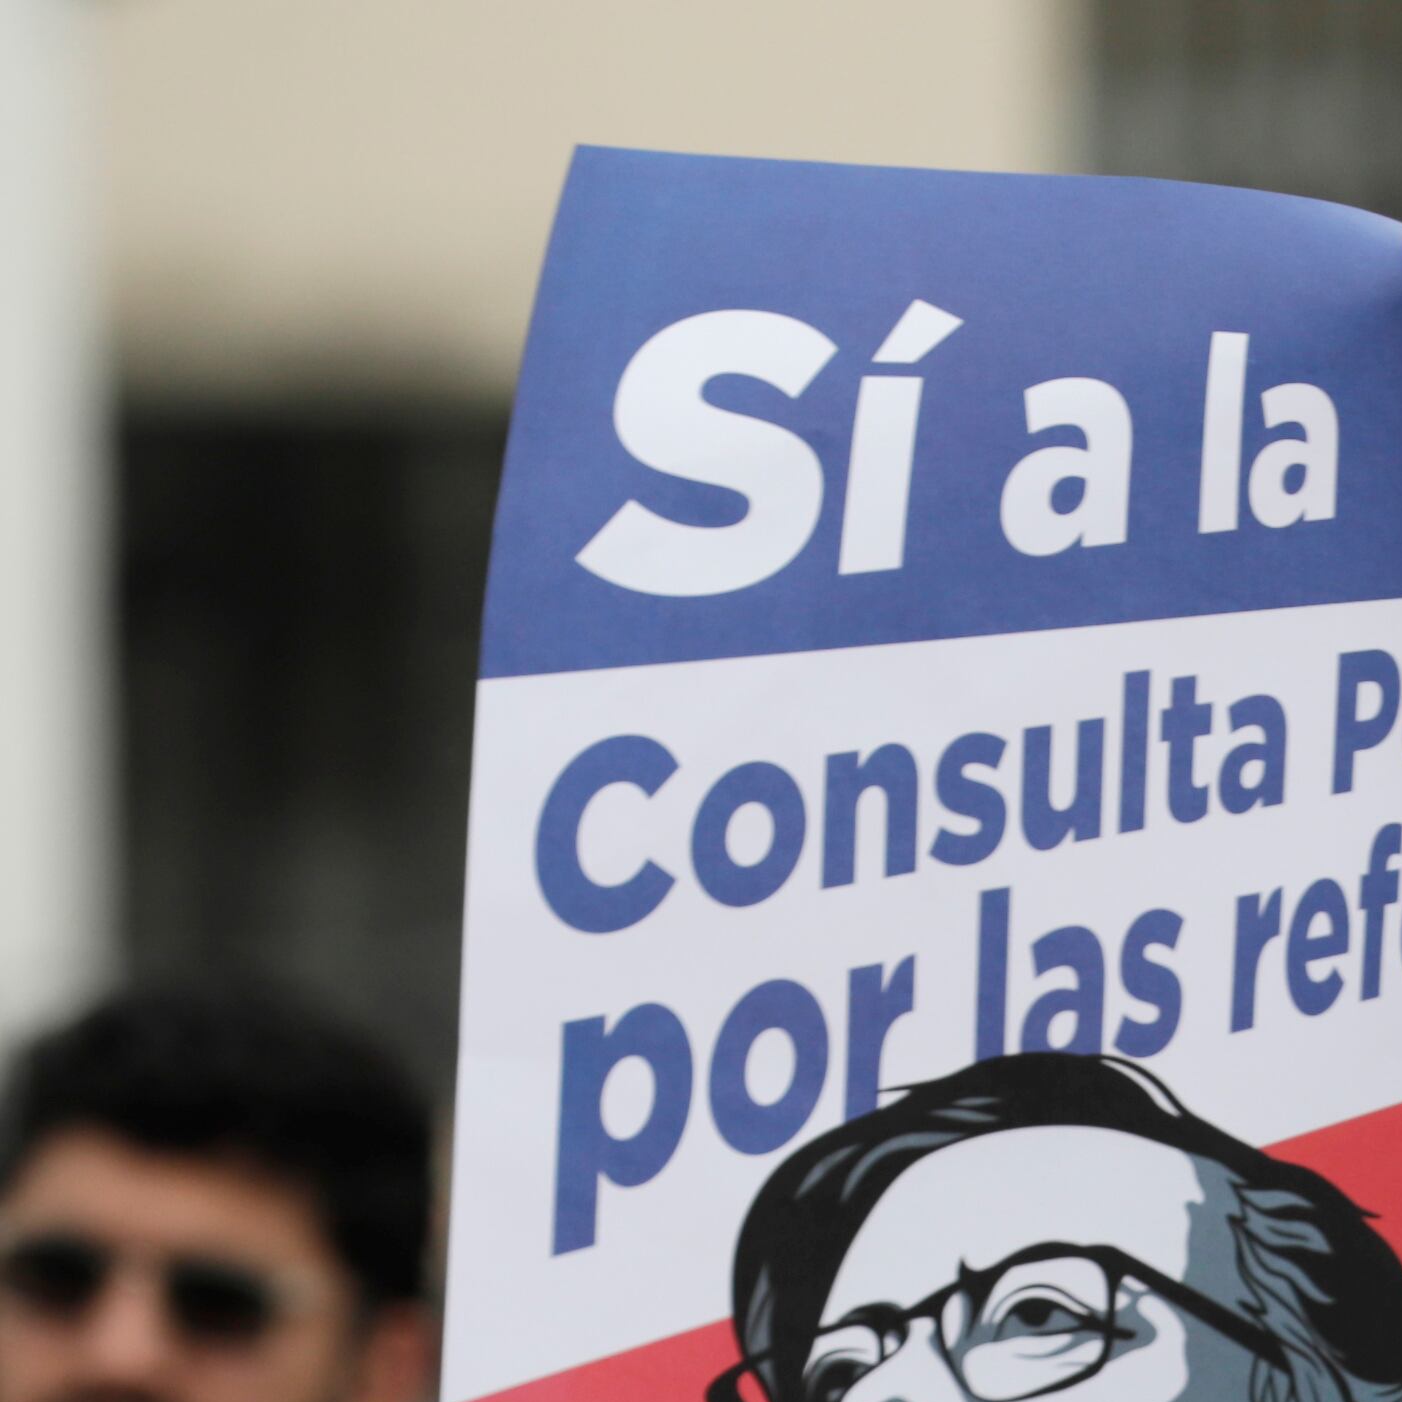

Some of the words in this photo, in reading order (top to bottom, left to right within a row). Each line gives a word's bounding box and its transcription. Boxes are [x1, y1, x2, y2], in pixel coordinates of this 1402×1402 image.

[574, 297, 965, 598] Sí
[999, 375, 1134, 558] a
[1197, 329, 1339, 535] la
[532, 668, 1288, 935] Consulta
[550, 953, 917, 1258] por
[973, 885, 1184, 1064] las
